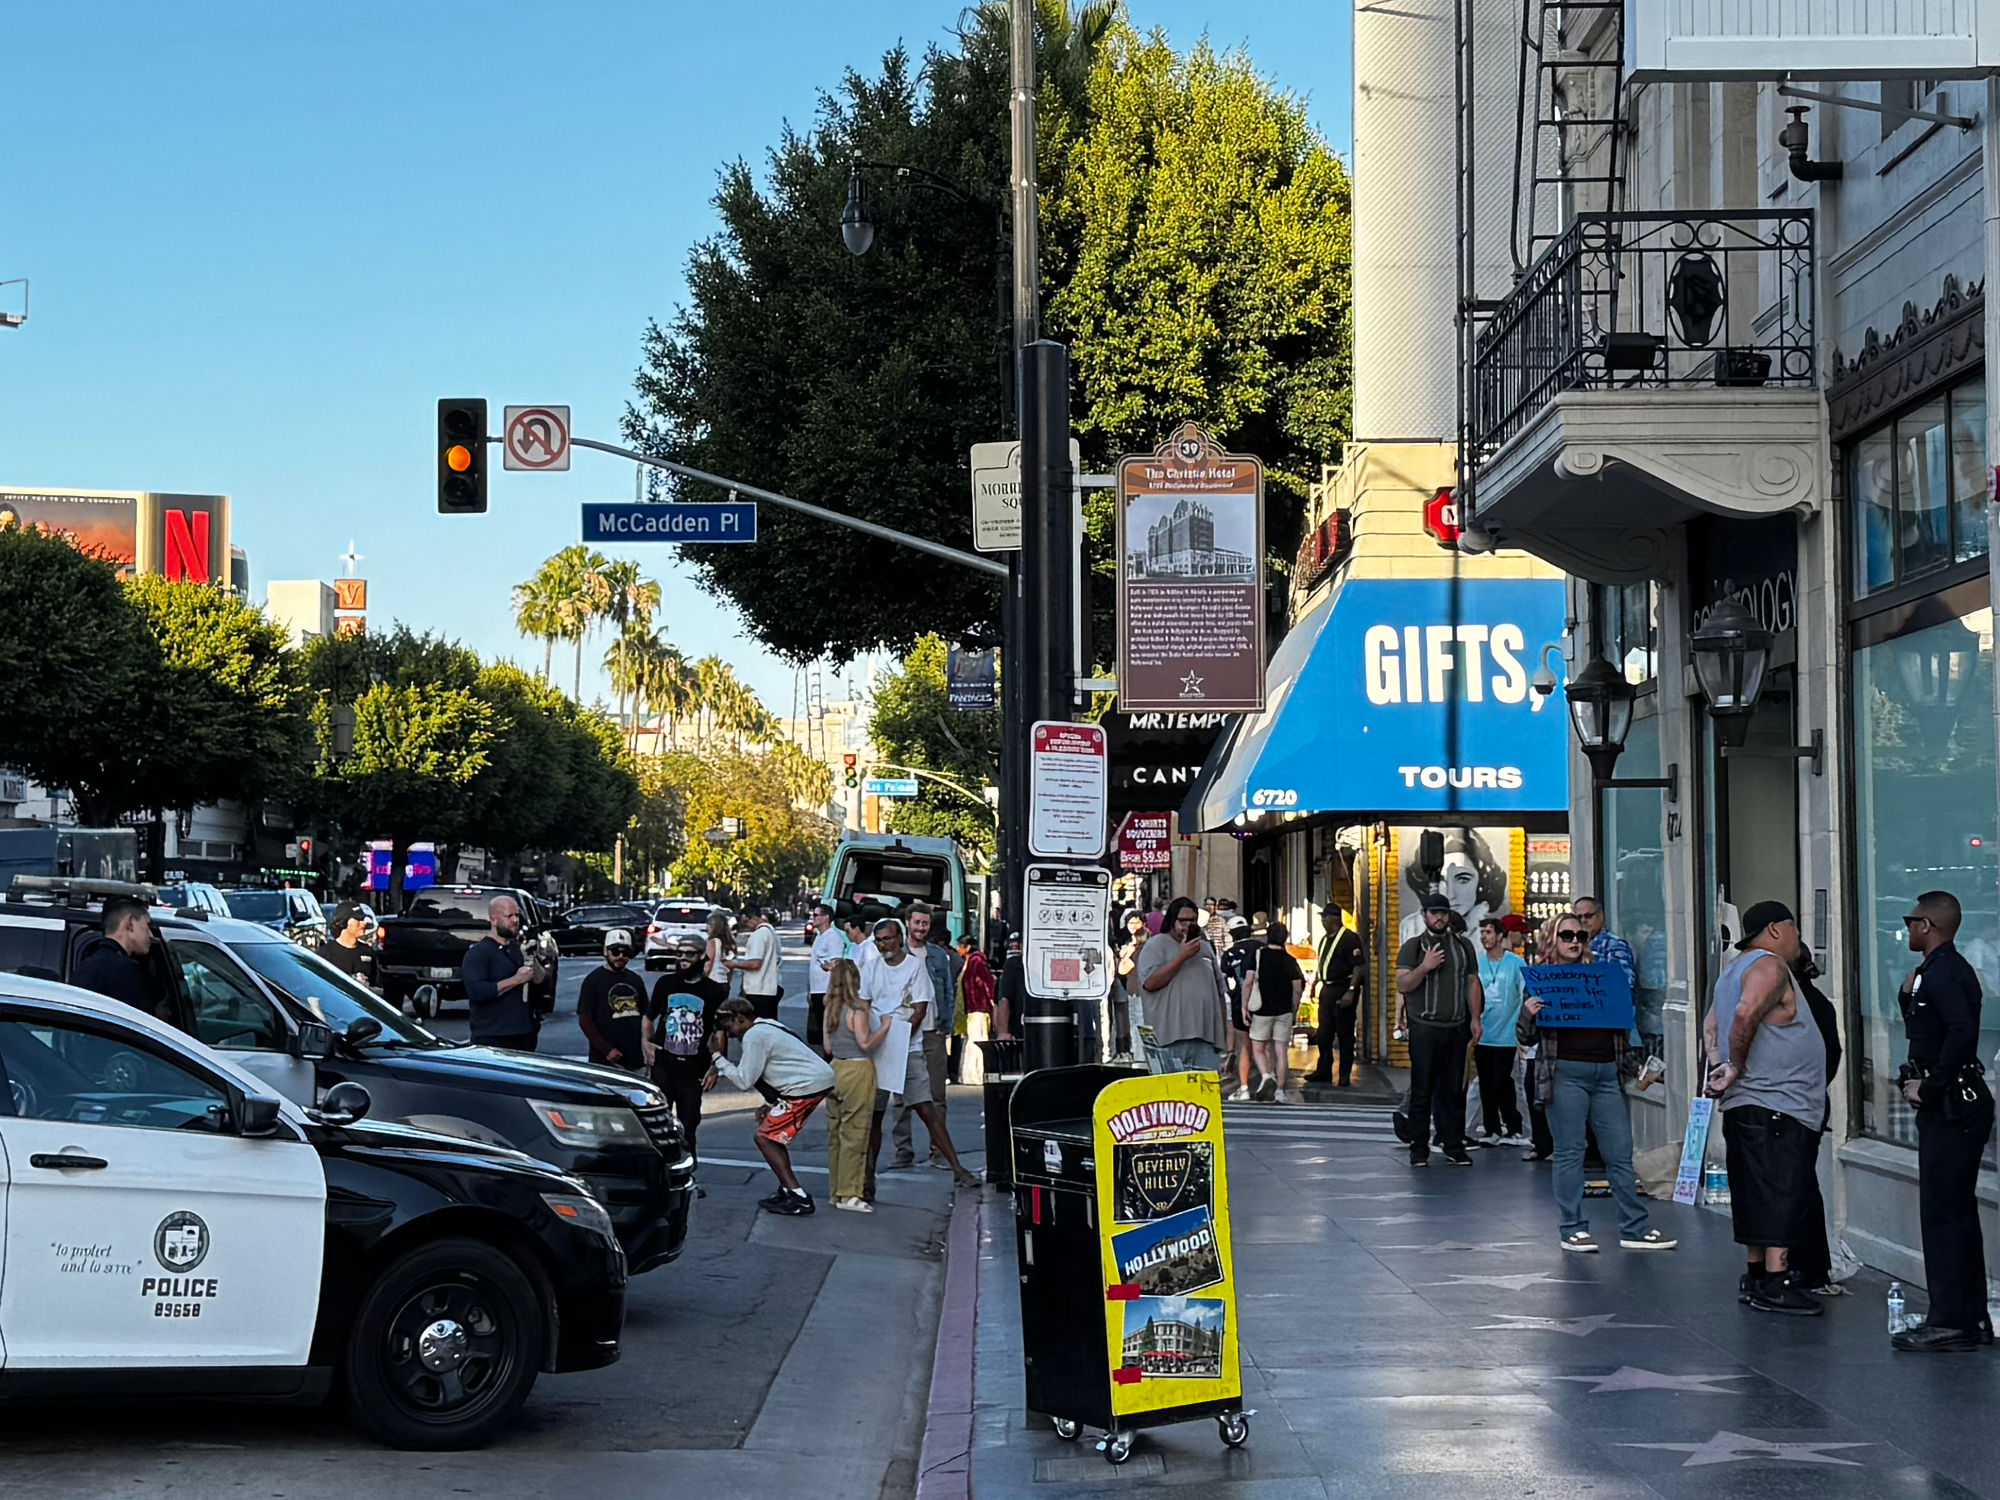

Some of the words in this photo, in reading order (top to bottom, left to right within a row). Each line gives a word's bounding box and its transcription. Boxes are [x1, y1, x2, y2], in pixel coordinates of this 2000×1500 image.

[1182, 443, 1199, 454] 39
[1209, 467, 1236, 478] Hotel
[1002, 497, 1021, 509] SQ
[599, 512, 709, 532] McCadden
[721, 513, 739, 532] Pl
[1398, 766, 1523, 789] TOURS
[1252, 788, 1298, 806] 6720
[1107, 1101, 1210, 1141] HOLLYWOOD
[1137, 1158, 1186, 1174] BEVERLY
[1145, 1175, 1178, 1190] HILLS
[1124, 1229, 1211, 1276] HOLLYWOOD
[141, 1278, 218, 1298] POLICE
[154, 1303, 201, 1318] 89658
